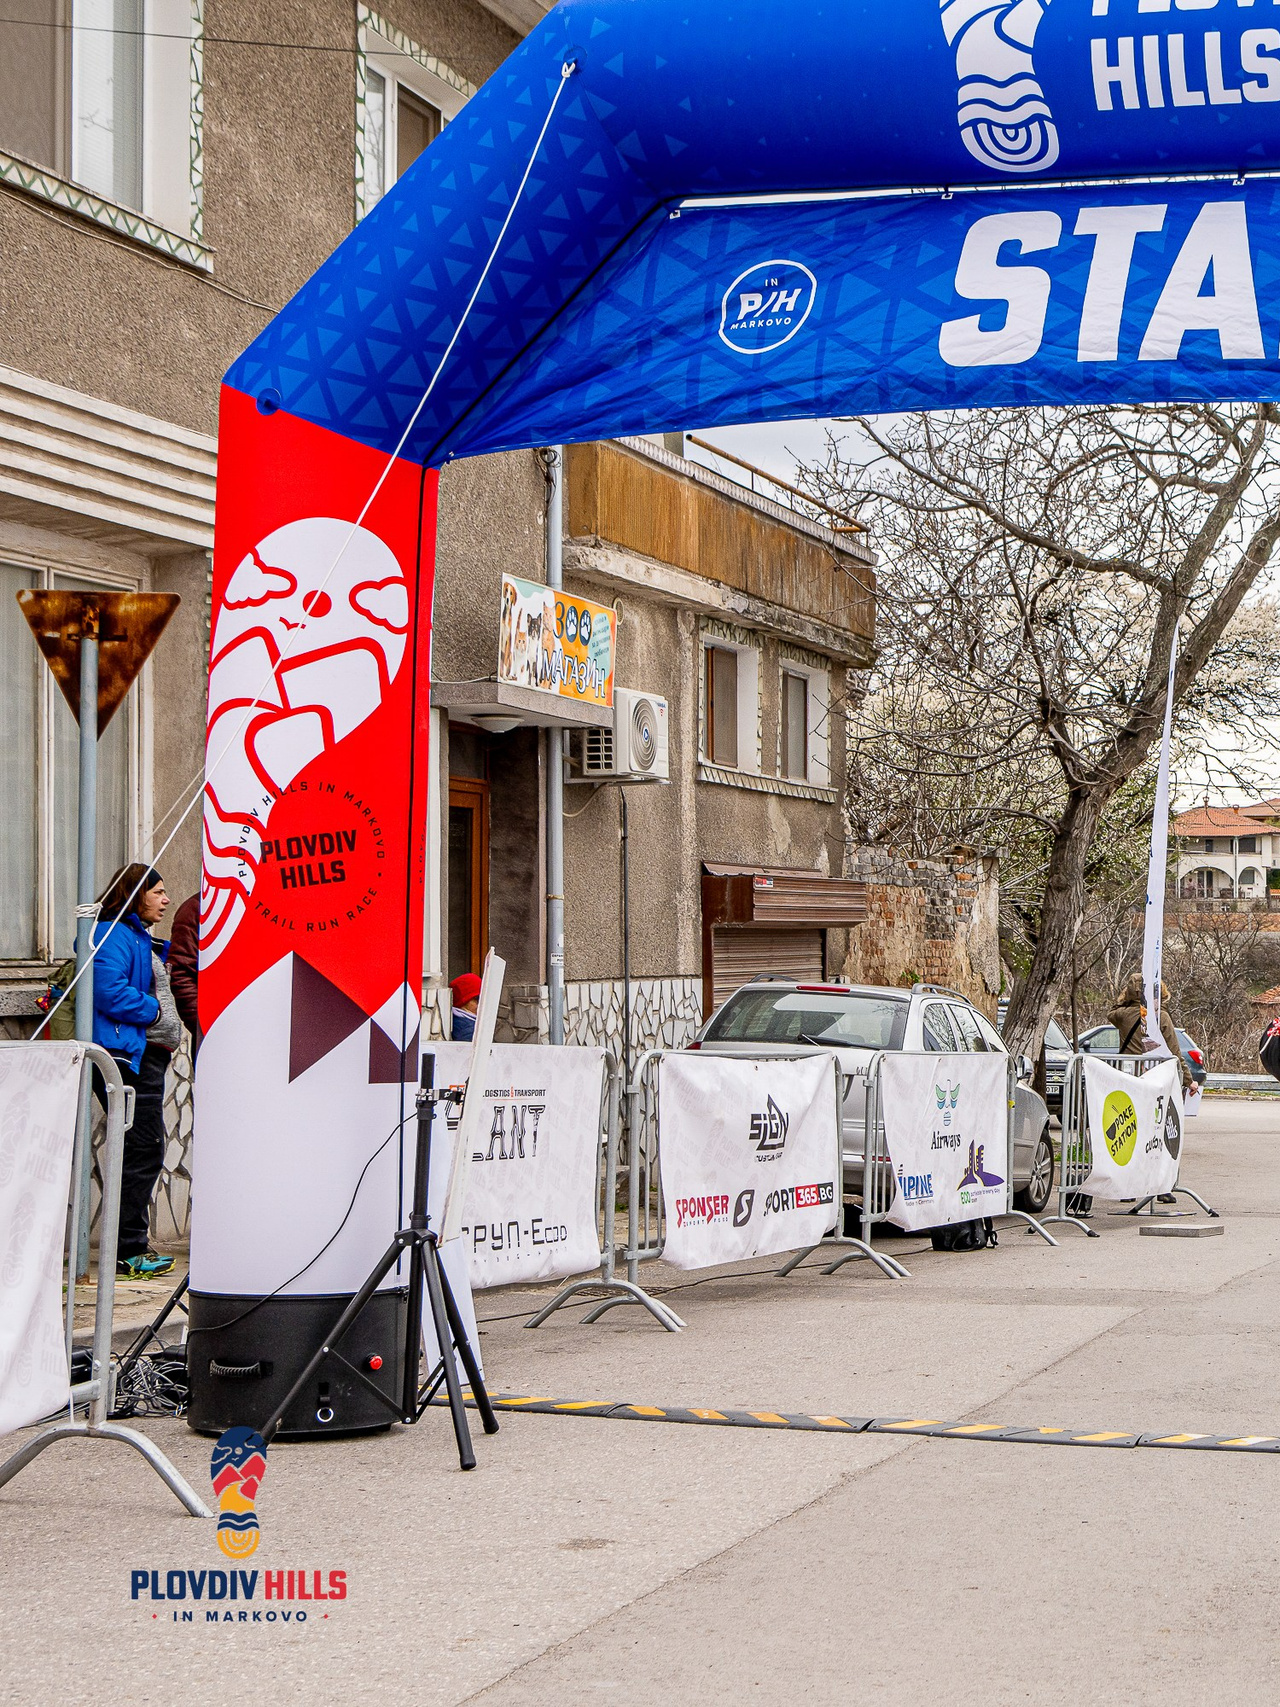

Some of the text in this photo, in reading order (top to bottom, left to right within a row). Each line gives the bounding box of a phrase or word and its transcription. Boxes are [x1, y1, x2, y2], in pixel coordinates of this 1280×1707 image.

[764, 277, 779, 287] IN
[737, 288, 802, 320] P/H
[730, 317, 792, 330] MARKOVO
[542, 648, 606, 698] МАГАЗИН
[237, 807, 260, 879] PLOVDIV
[261, 781, 309, 807] HILLS
[318, 781, 336, 793] IN
[343, 790, 385, 860] MARKOVO
[260, 829, 358, 864] PLOVDIV
[280, 860, 346, 890] HILLS
[254, 887, 378, 932] TRAIL RUN RACE
[514, 1088, 546, 1098] TRANSPORT
[1114, 1104, 1134, 1131] POKE
[931, 1131, 961, 1152] Airways
[1110, 1120, 1137, 1157] STATION
[676, 1194, 729, 1229] SPONSER
